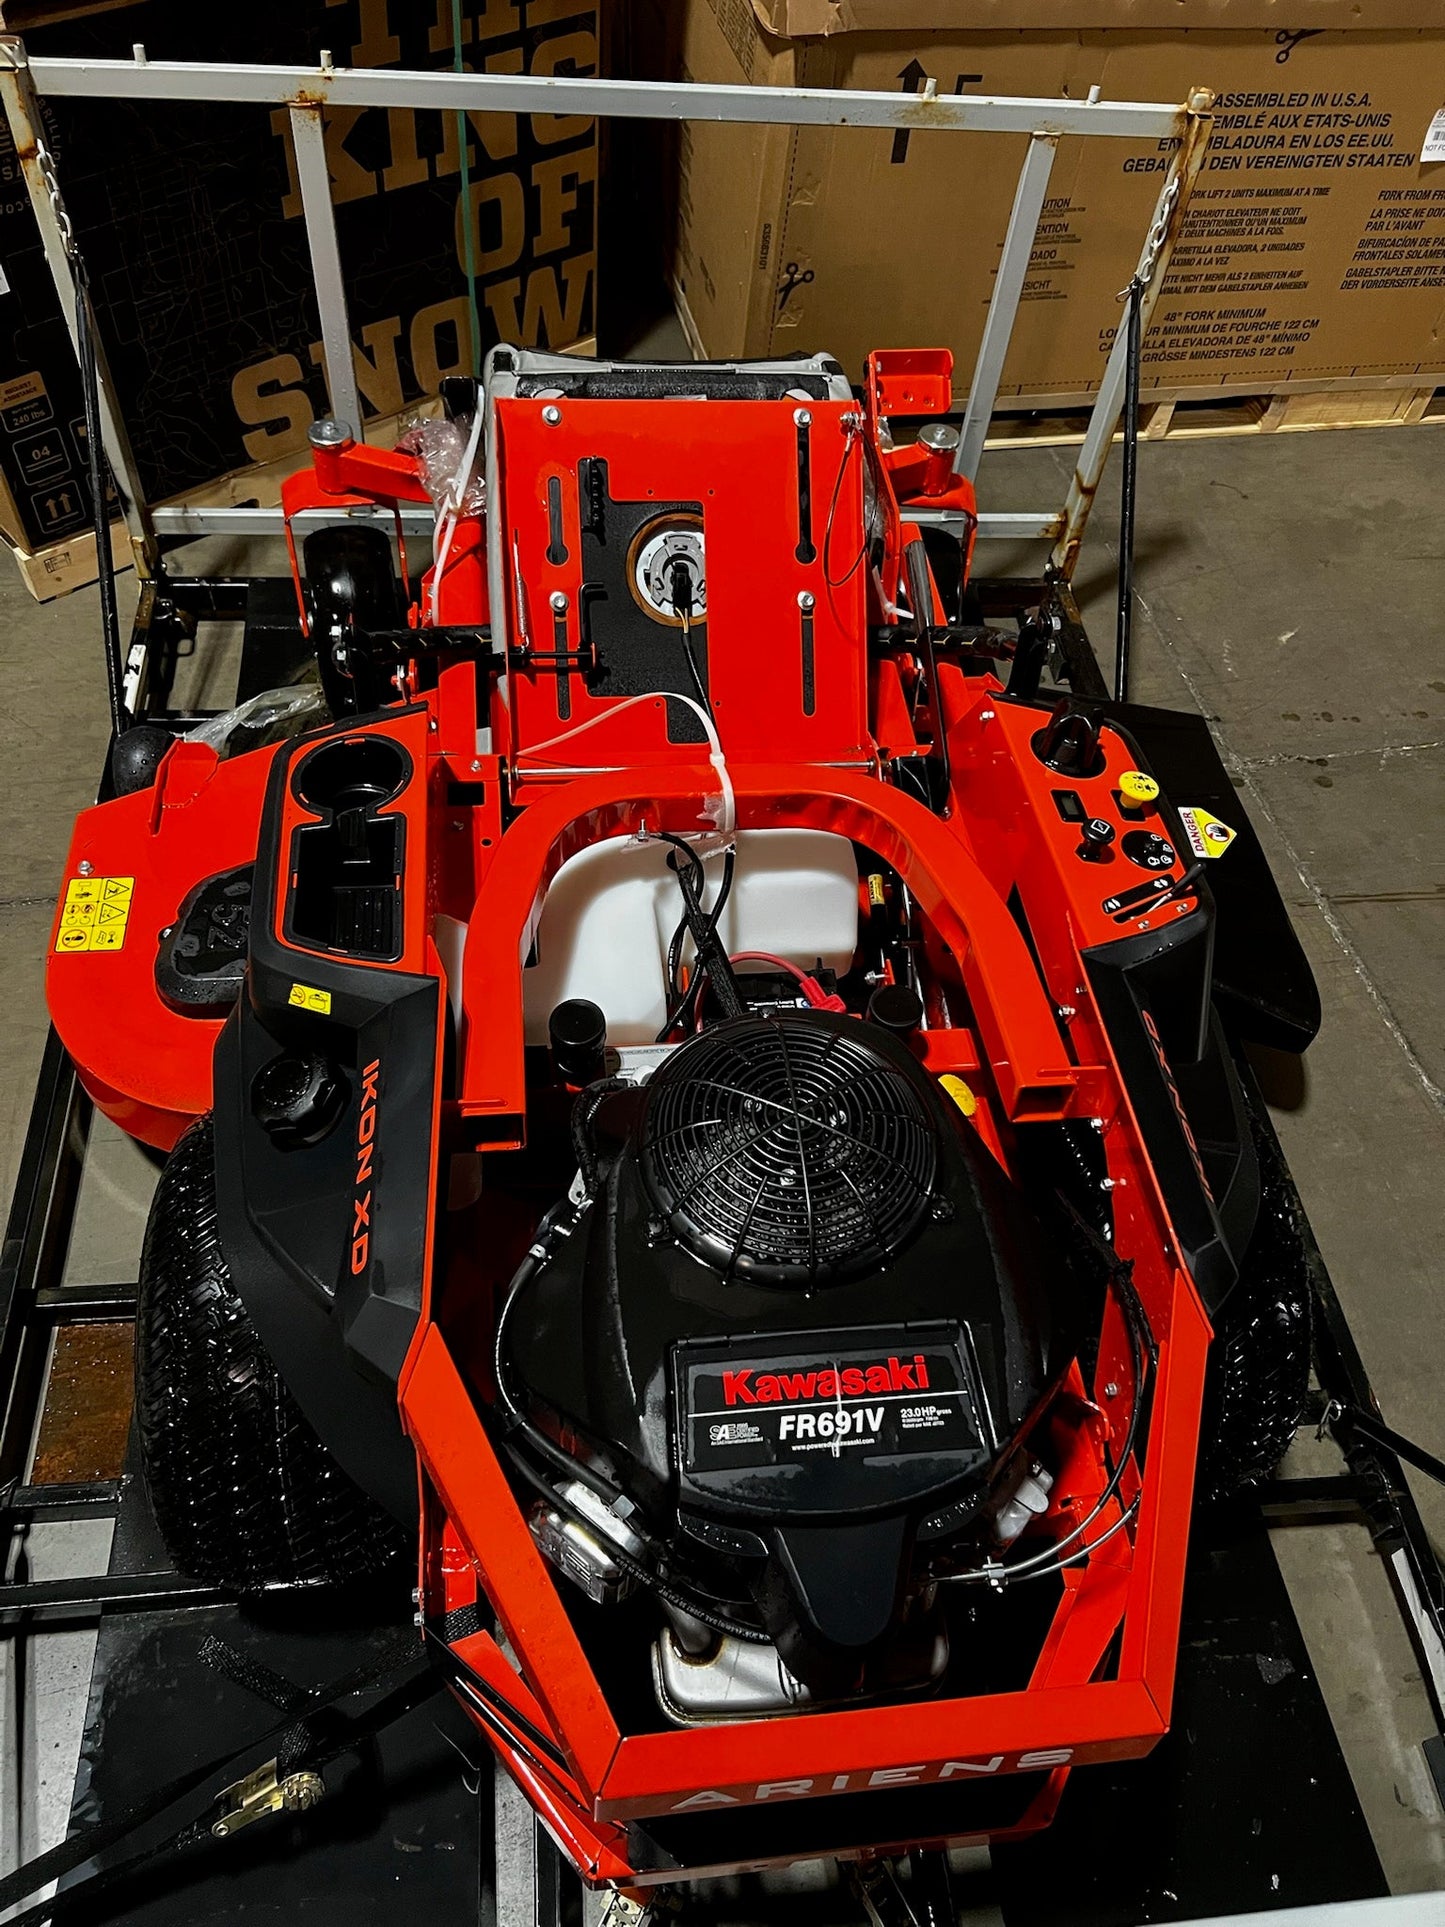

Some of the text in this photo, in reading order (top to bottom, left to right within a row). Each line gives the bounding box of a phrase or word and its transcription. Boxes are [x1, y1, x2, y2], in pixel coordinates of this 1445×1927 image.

[1212, 93, 1372, 108] ASSEMBLED IN U.S.A.
[1268, 114, 1302, 128] AUX
[1303, 113, 1392, 128] ETATS-UNIS
[1289, 135, 1312, 149] EN
[1313, 134, 1345, 148] LOS
[1347, 134, 1394, 148] EE.UU.
[1209, 156, 1244, 170] DEN
[1246, 154, 1344, 169] VEREINIGTEN
[1346, 153, 1415, 168] STAATEN
[1207, 190, 1224, 199] LIFT
[1224, 190, 1232, 199] 2
[1232, 189, 1255, 198] UNITS
[1255, 187, 1294, 197] MAXIMUM
[1293, 187, 1305, 196] AT
[1304, 187, 1311, 196] A
[1312, 187, 1331, 196] TIME
[1377, 190, 1404, 200] FORK
[1404, 190, 1432, 200] FROM
[455, 146, 597, 278] OF
[1191, 209, 1226, 218] CHARIOT
[1225, 208, 1269, 217] ELEVATEUR
[1270, 207, 1282, 216] NE
[1282, 207, 1302, 216] DOIT
[1370, 208, 1383, 219] LA
[1384, 208, 1412, 218] PRISE
[1413, 208, 1426, 218] NE
[1269, 216, 1307, 225] MAXIMUM
[1365, 220, 1426, 231] PAR L'AVANT
[1184, 229, 1205, 238] DEUX
[1206, 228, 1246, 237] MACHINES
[1246, 227, 1253, 236] A
[1254, 227, 1264, 236] LA
[1260, 243, 1267, 252] 2
[1267, 242, 1306, 251] UNIDADES
[1418, 237, 1432, 247] DE
[1195, 257, 1202, 266] A
[1203, 257, 1214, 266] LA
[1215, 256, 1230, 265] VEZ
[1352, 250, 1404, 260] FRONTALES
[1179, 273, 1204, 282] NICHT
[1226, 271, 1243, 281] ALS
[1243, 271, 1250, 280] 2
[1345, 267, 1413, 278] GABELSTAPLER
[1413, 266, 1440, 276] BITTE
[1184, 285, 1199, 294] MIT
[1199, 284, 1217, 293] DEM
[1217, 282, 1273, 292] GABELSTAPLER
[1340, 280, 1359, 290] DER
[1360, 278, 1419, 289] VORDERSEITE
[1183, 310, 1216, 321] FORK
[1216, 308, 1267, 319] MINIMUM
[1162, 324, 1210, 336] MINIMUM
[1212, 323, 1228, 333] DE
[1229, 321, 1282, 332] FOURCHE
[1283, 320, 1301, 329] 122
[1302, 319, 1320, 329] CM
[1168, 336, 1233, 348] ELEVADORA
[1236, 335, 1252, 345] DE
[1271, 331, 1310, 343] MÍNIMO
[232, 252, 597, 462] SNOW
[1189, 347, 1257, 359] MINDESTENS
[1260, 346, 1276, 356] 122
[1278, 346, 1295, 355] CM
[13, 414, 30, 426] 240
[32, 445, 50, 460] 04
[1183, 811, 1204, 852] DANGER
[351, 1058, 380, 1276] IKON XD
[722, 1355, 929, 1406] Kawasaki
[779, 1407, 884, 1440] FR691V
[670, 1748, 1074, 1811] ARIENS
